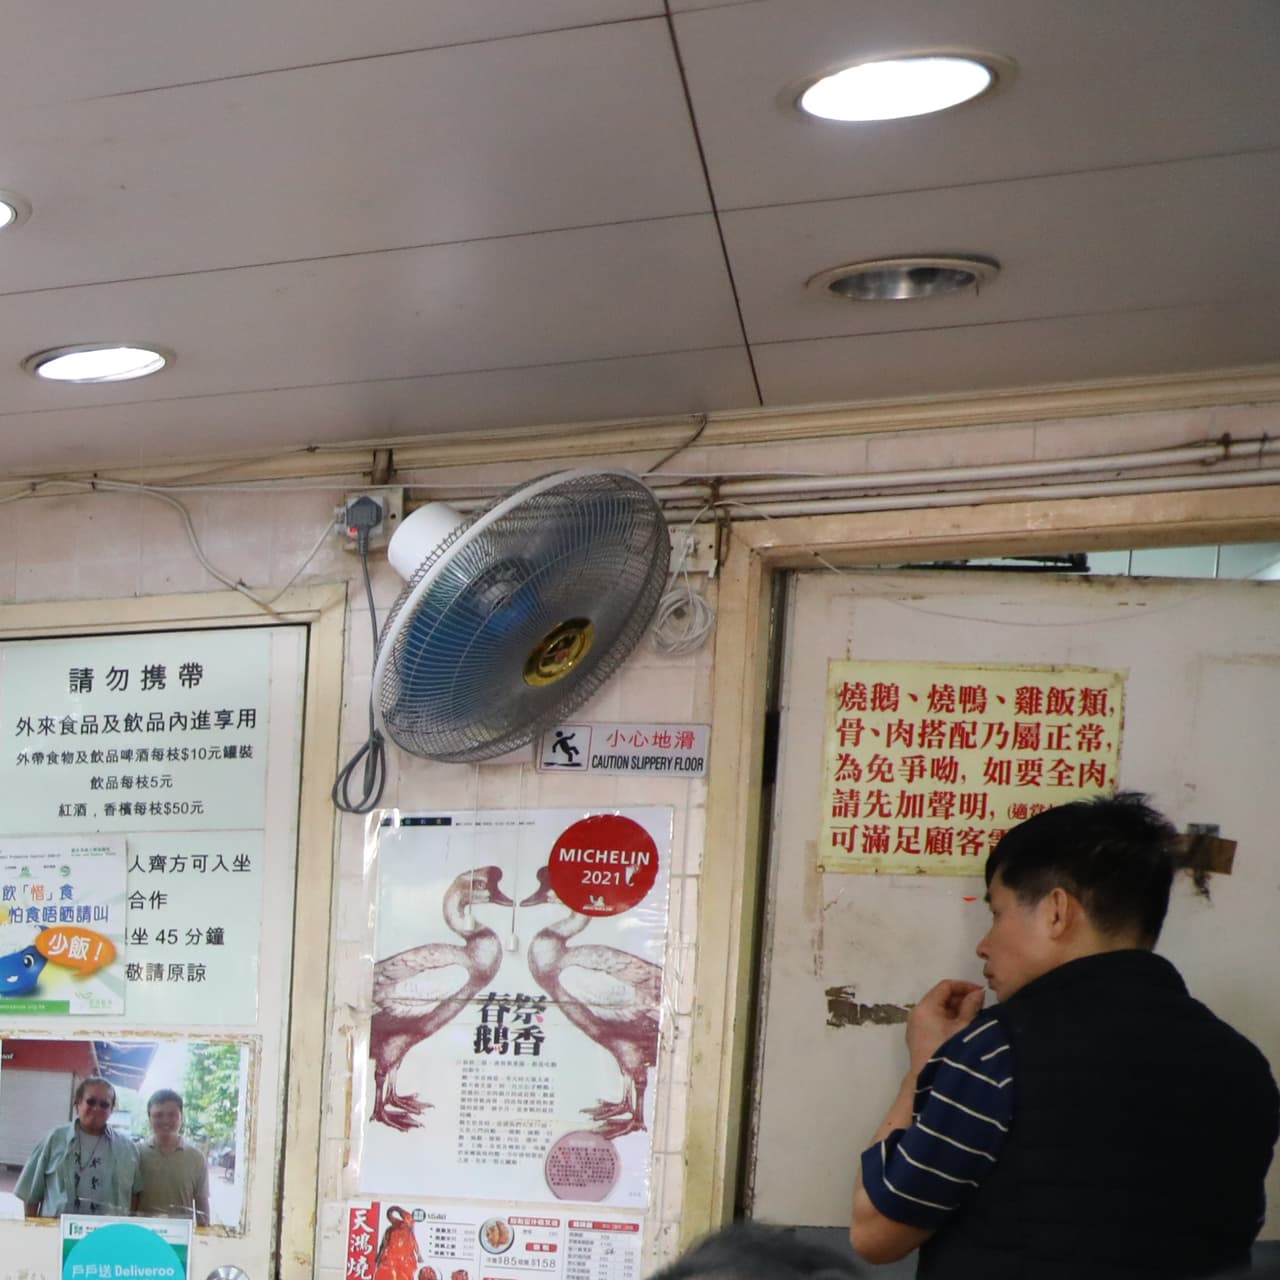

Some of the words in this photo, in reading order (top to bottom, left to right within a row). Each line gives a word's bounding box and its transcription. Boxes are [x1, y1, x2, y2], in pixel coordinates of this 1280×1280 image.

[606, 729, 695, 750] 小心地滑
[592, 754, 629, 769] CAUTION
[631, 756, 672, 770] SLIPPERY
[674, 757, 704, 771] FLOOR
[128, 853, 252, 875] 人齊方可入坐
[559, 848, 650, 866] MICHELIN
[581, 870, 620, 886] 2021
[128, 890, 168, 909] 合作
[155, 928, 179, 946] 45
[184, 926, 225, 947] 分鐘
[125, 962, 207, 983] 敬請原諒
[115, 1265, 175, 1277] Deliveroo
